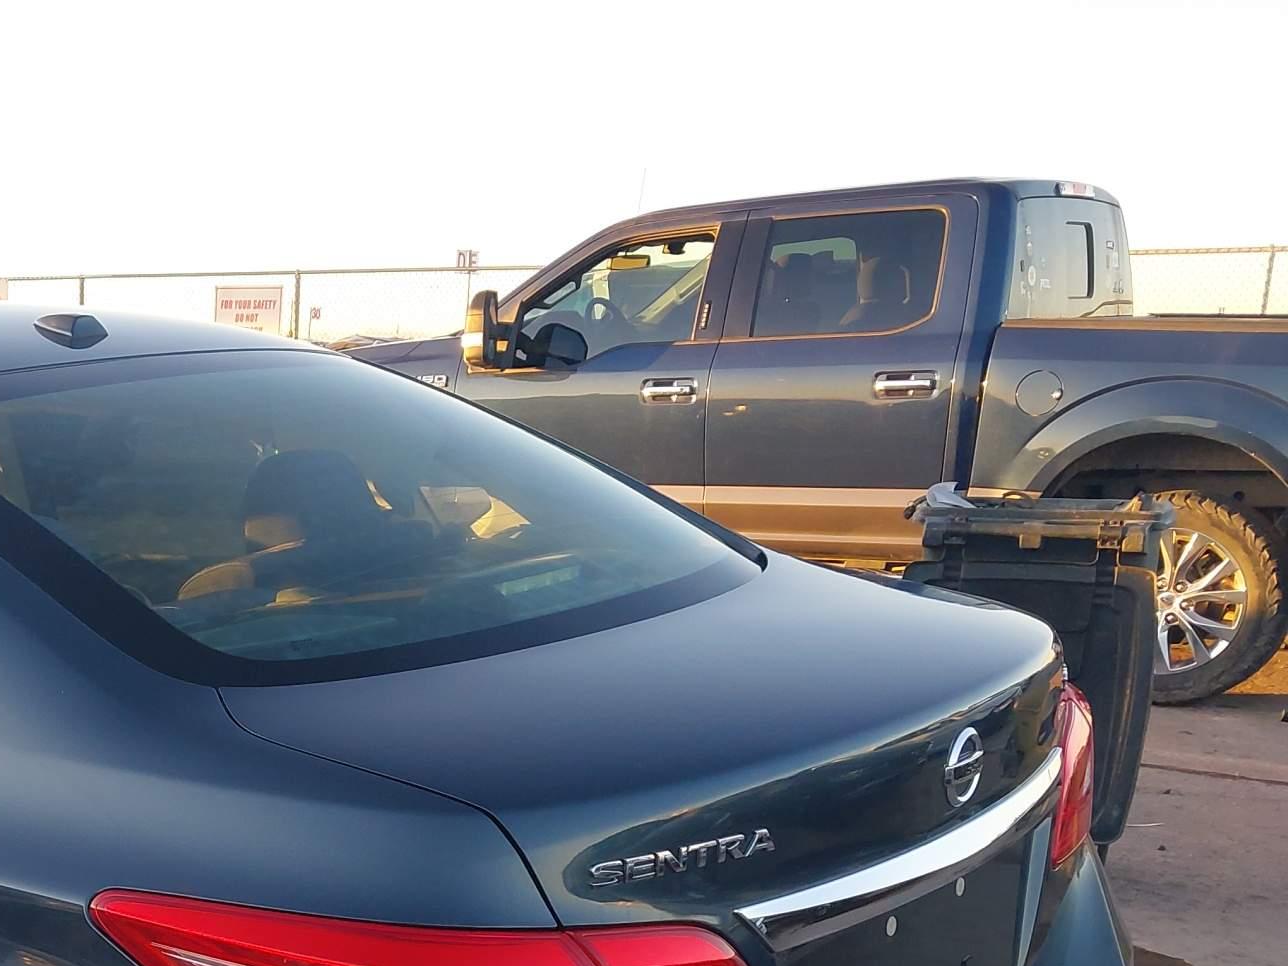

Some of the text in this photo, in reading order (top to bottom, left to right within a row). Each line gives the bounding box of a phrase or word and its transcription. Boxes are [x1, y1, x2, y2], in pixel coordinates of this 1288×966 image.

[220, 299, 278, 310] FOR YOUR SAFETY
[234, 313, 259, 323] DO NOT
[589, 828, 777, 887] SENTRA
